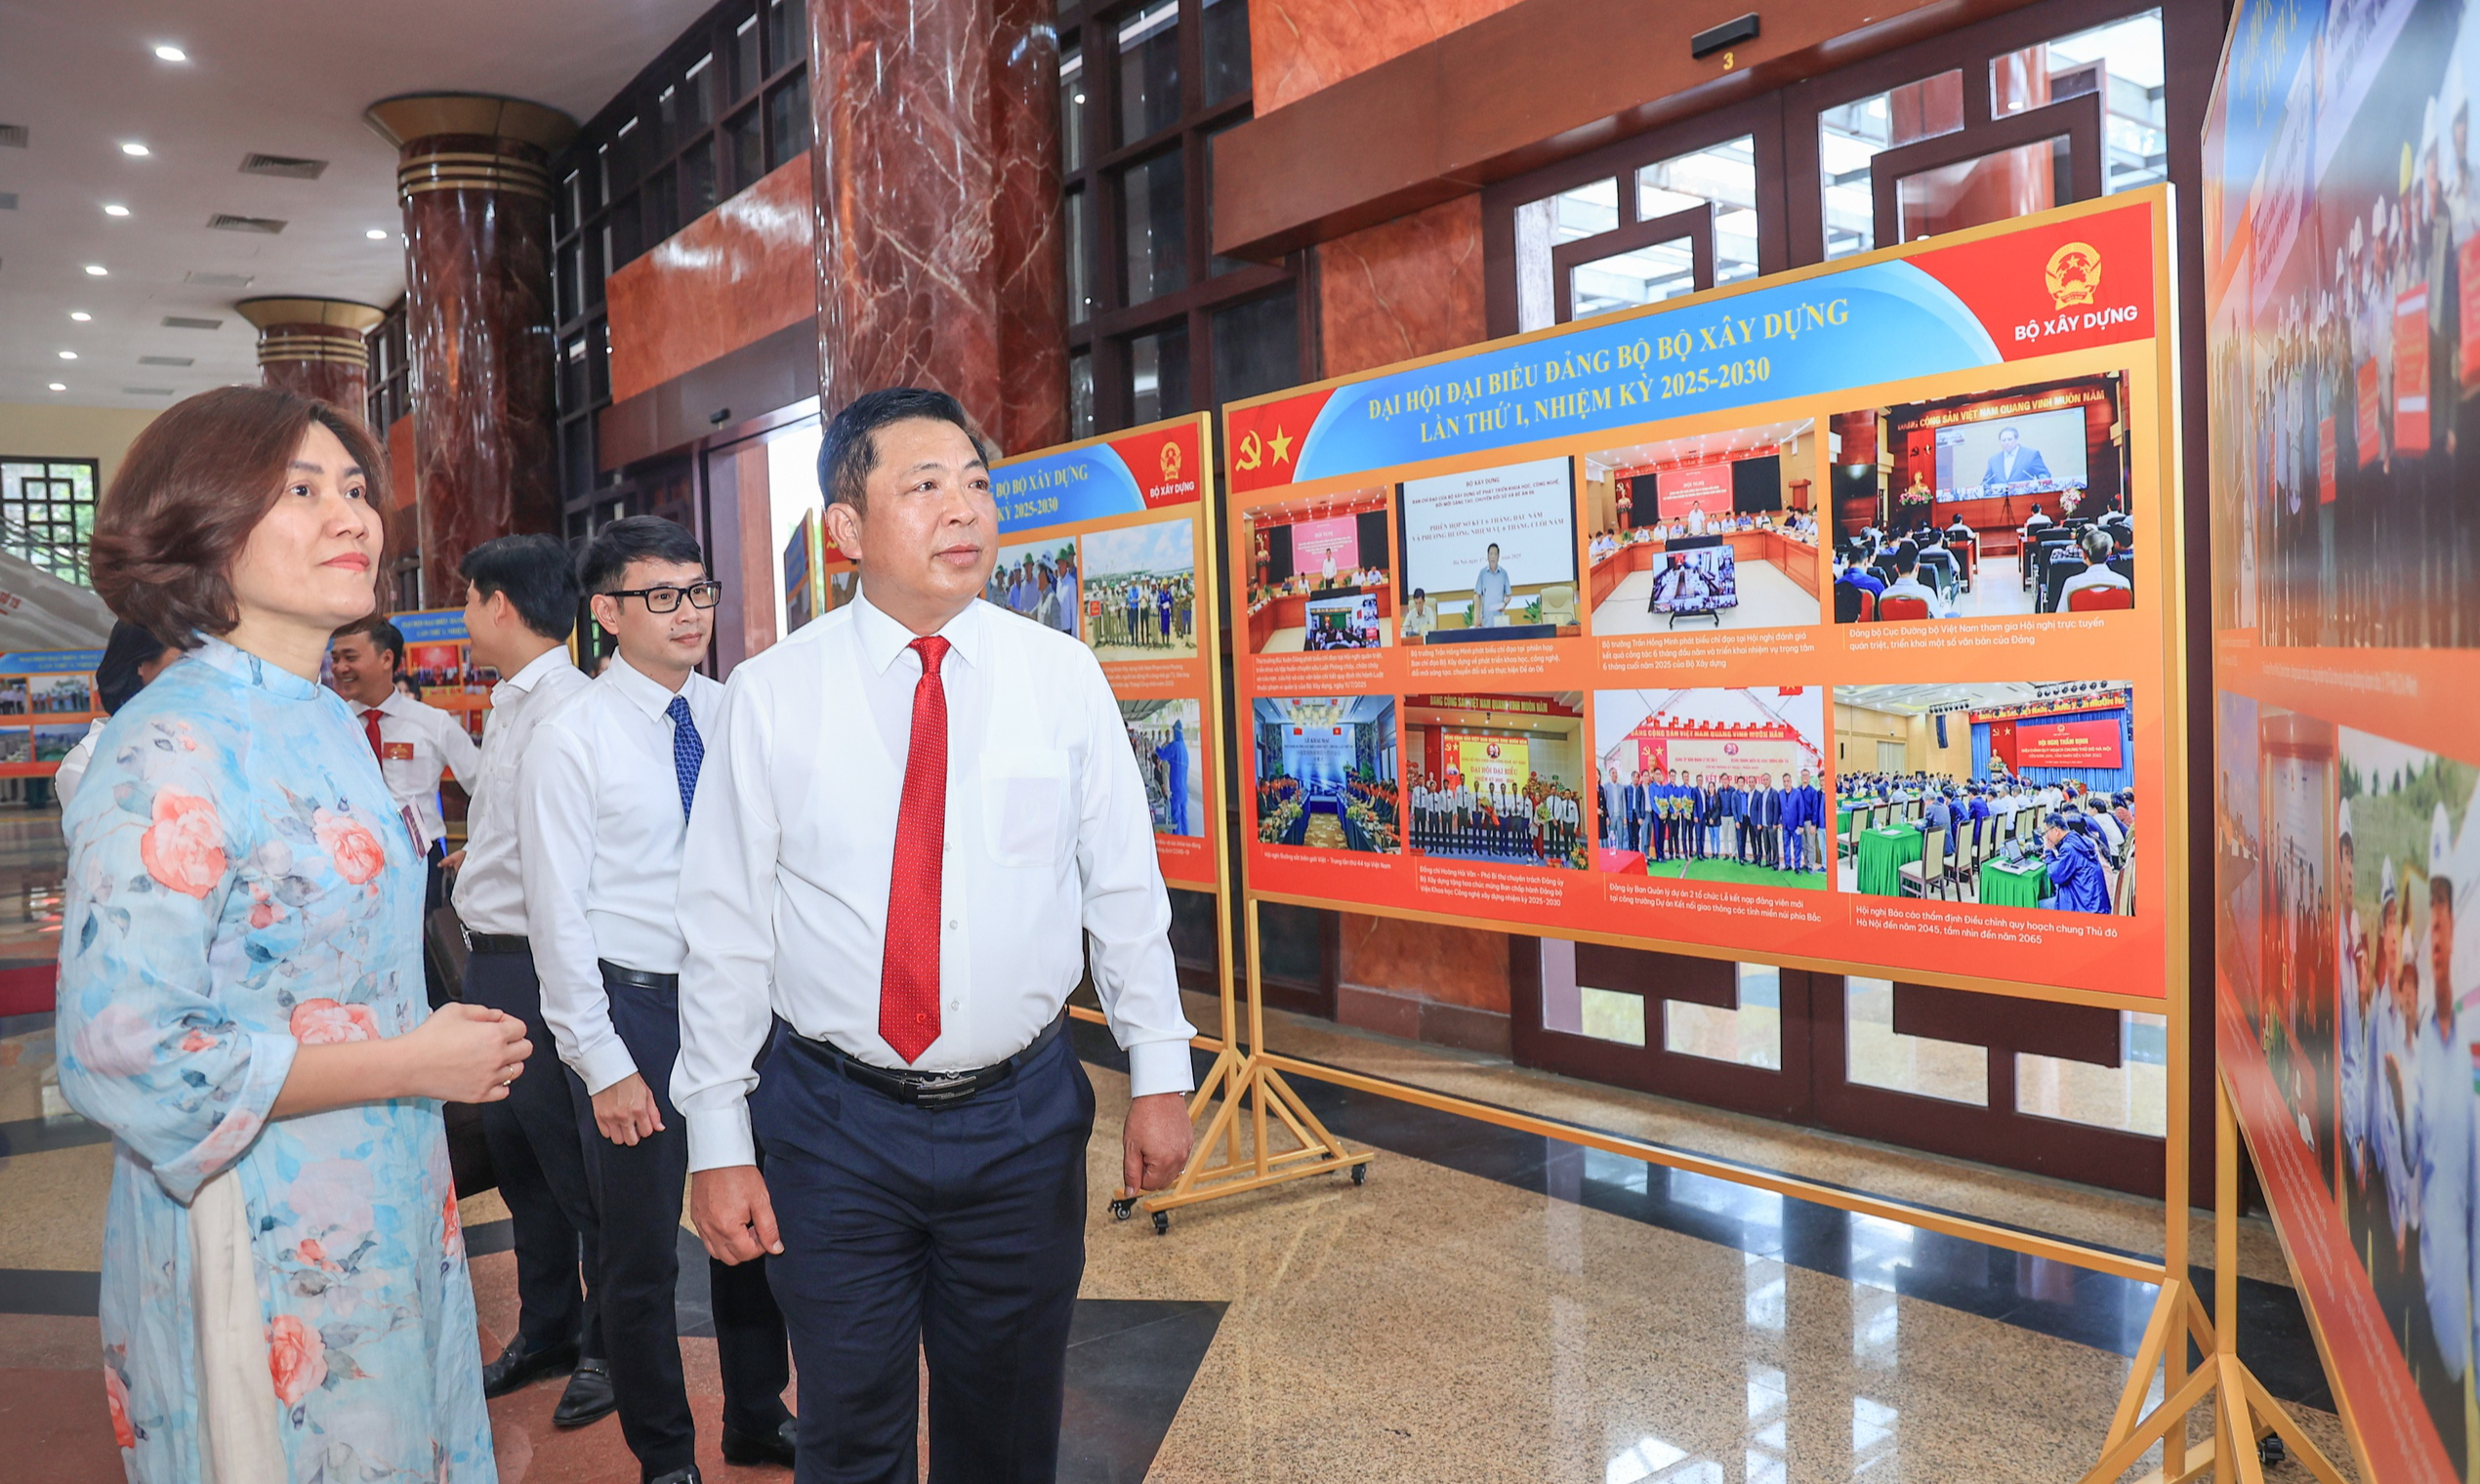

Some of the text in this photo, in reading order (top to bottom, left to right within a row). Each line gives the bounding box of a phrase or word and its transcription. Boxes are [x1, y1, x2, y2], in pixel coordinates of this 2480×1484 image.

[1723, 52, 1734, 70] 3
[2015, 306, 2137, 343] BỘ XÂY DỰNG
[1370, 299, 1848, 421] ĐẠI HỘI ĐẠI BIỂU ĐẢNG BỘ BỘ XÂY DỰNG
[1422, 356, 1770, 442] LẦN THỨ I, NHIỆM KỲ 2025-2030
[1920, 416, 1941, 429] CỘNG
[1941, 413, 1959, 426] SẢN
[1962, 410, 1979, 421] VIỆT
[1978, 407, 1999, 420] NAM
[2001, 401, 2031, 415] QUANG
[2033, 397, 2053, 409] VINH
[2052, 393, 2081, 409] MUÔN
[2084, 390, 2104, 401] NĂM
[996, 478, 1011, 500] BỘ
[1013, 476, 1027, 496] BỘ
[1029, 470, 1051, 490] XÂY
[1054, 465, 1088, 487] DỰNG
[1150, 481, 1195, 499] BỘ XÂY DỰNG
[997, 497, 1058, 522] KỲ 2025-2030
[1602, 640, 1610, 649] Bộ
[1611, 640, 1632, 649] trưởng
[1646, 638, 1663, 647] Hồng
[1679, 638, 1694, 646] phát
[1695, 635, 1710, 644] biểu
[1721, 636, 1735, 644] đạo
[1747, 634, 1758, 642] Hội
[1759, 634, 1775, 643] nghị
[1795, 632, 1806, 641] giá
[1849, 629, 1870, 639] Đảng
[1871, 628, 1882, 638] bộ
[1882, 628, 1898, 637] Cục
[1901, 627, 1927, 637] Đường
[1928, 626, 1939, 636] bộ
[1941, 625, 1958, 635] Việt
[1959, 624, 1979, 633] Nam
[2005, 624, 2018, 633] gia
[2019, 621, 2035, 632] Hội
[2037, 620, 2055, 631] nghị
[2057, 620, 2076, 630] trực
[2079, 617, 2104, 629] tuyến
[1602, 651, 1612, 660] kết
[1613, 651, 1625, 660] quả
[1626, 651, 1641, 660] công
[1659, 649, 1678, 658] tháng
[1748, 645, 1769, 655] nhiệm
[1780, 645, 1798, 654] trọng
[1799, 643, 1815, 652] tâm
[1849, 641, 1869, 651] quán
[1870, 640, 1889, 650] triệt,
[1890, 639, 1909, 648] triển
[1928, 639, 1945, 648] một
[1947, 637, 1957, 646] số
[1958, 638, 1974, 646] văn
[1975, 637, 1992, 645] bản
[1993, 636, 2009, 644] của
[2010, 635, 2036, 645] Đảng
[1608, 663, 1627, 672] tháng
[1684, 660, 1695, 669] Bộ
[1696, 660, 1709, 669] Xây
[1710, 659, 1726, 668] dựng
[1609, 883, 1626, 893] Đảng
[1647, 886, 1664, 895] Quản
[1672, 889, 1679, 898] dự
[1695, 889, 1702, 899] tổ
[1720, 892, 1729, 901] Lễ
[1730, 893, 1740, 902] kết
[1756, 896, 1774, 907] đảng
[1619, 895, 1634, 905] công
[1634, 897, 1655, 907] trường
[1656, 898, 1665, 908] Dự
[1674, 900, 1685, 909] Kết
[1697, 903, 1712, 912] giao
[1713, 904, 1732, 915] thông
[1733, 906, 1746, 915] các
[1747, 907, 1760, 916] tỉnh
[1760, 909, 1777, 918] miền
[1790, 912, 1806, 921] phía
[1807, 912, 1821, 922] Bắc
[1856, 906, 2118, 937] Hội nghị Báo cáo thẩm định Điều chỉnh quy hoạch chung Thủ đô
[1857, 918, 2043, 944] Hà Nội đến năm 2045, tầm nhìn đến năm 2065
